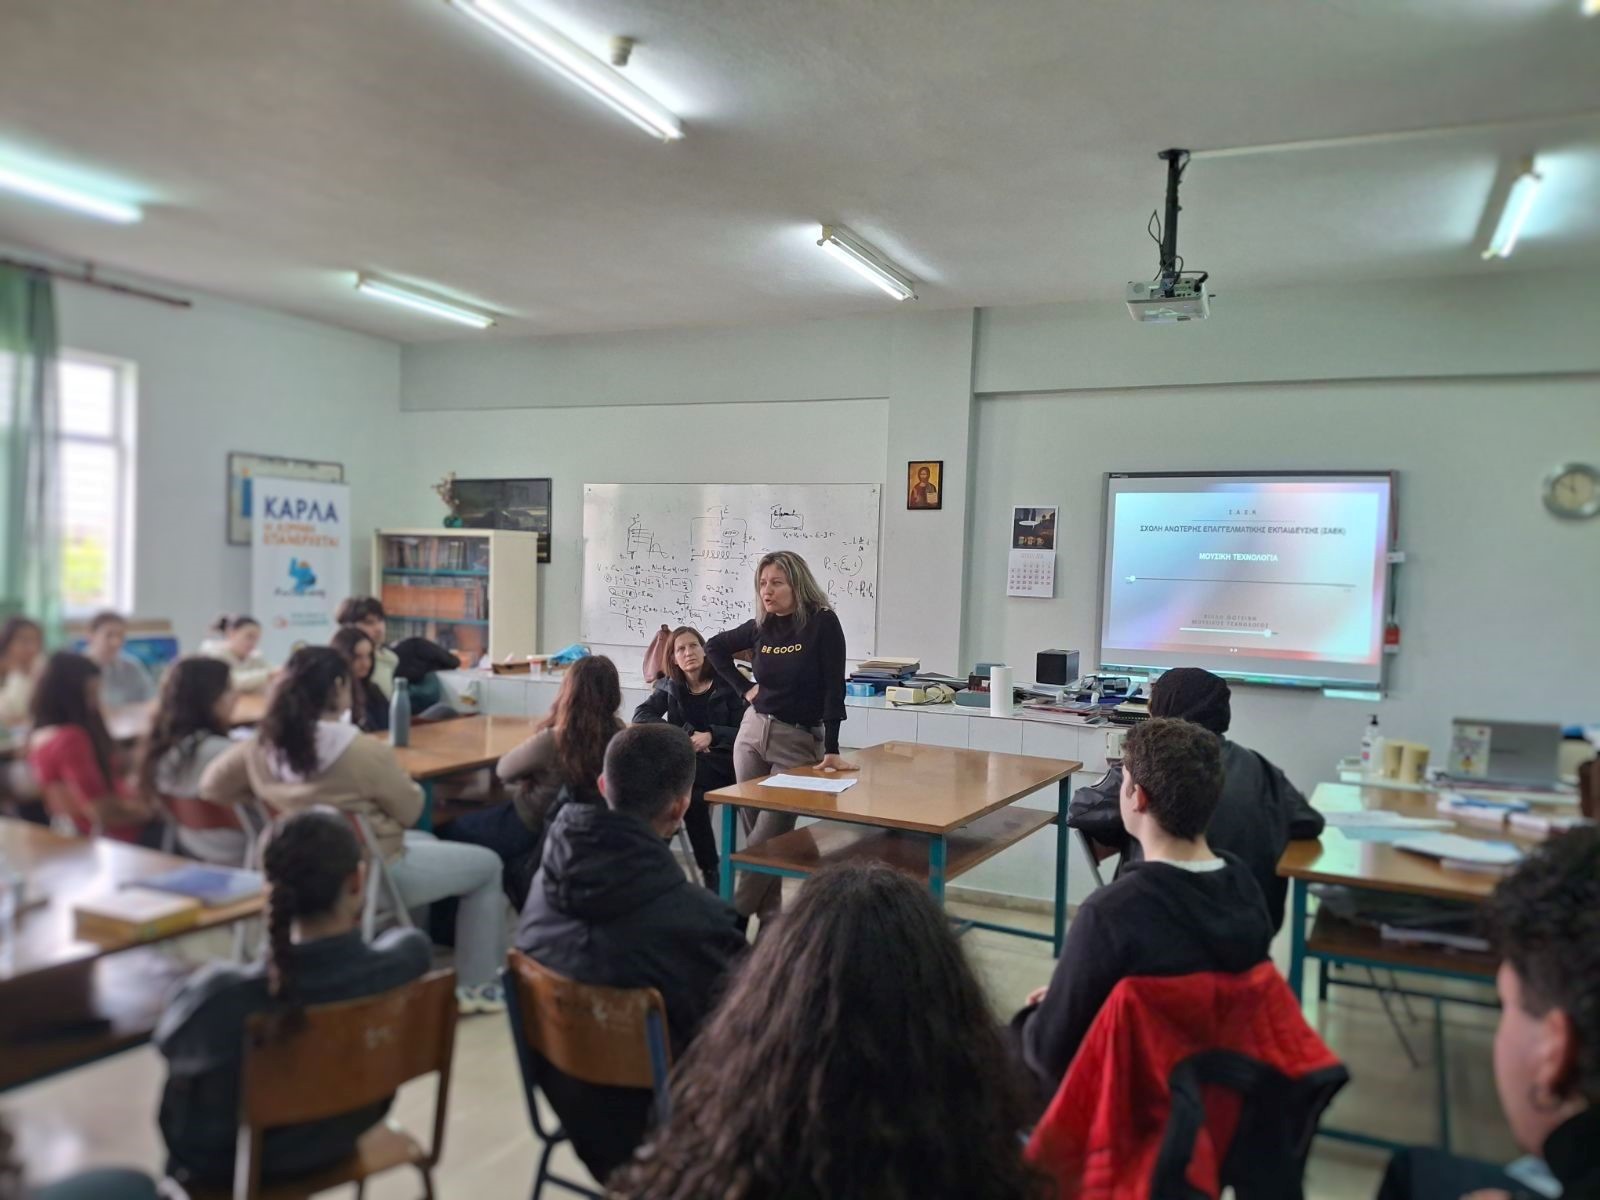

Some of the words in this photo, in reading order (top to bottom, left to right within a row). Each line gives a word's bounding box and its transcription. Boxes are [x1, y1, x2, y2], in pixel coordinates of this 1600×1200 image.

[263, 496, 340, 523] ΚΑΡΛΑ
[1164, 525, 1202, 533] ΑΝΩΤΕΡΗΣ
[1203, 526, 1266, 534] ΕΠΑΓΓΕΛΜΑΤΙΚΗΣ
[1199, 552, 1231, 561] ΜΟΥΣΙΚΗ
[1232, 553, 1279, 562] ΤΕΧΝΟΛΟΓΙΑ
[761, 645, 773, 654] BE
[773, 643, 802, 654] GOOD
